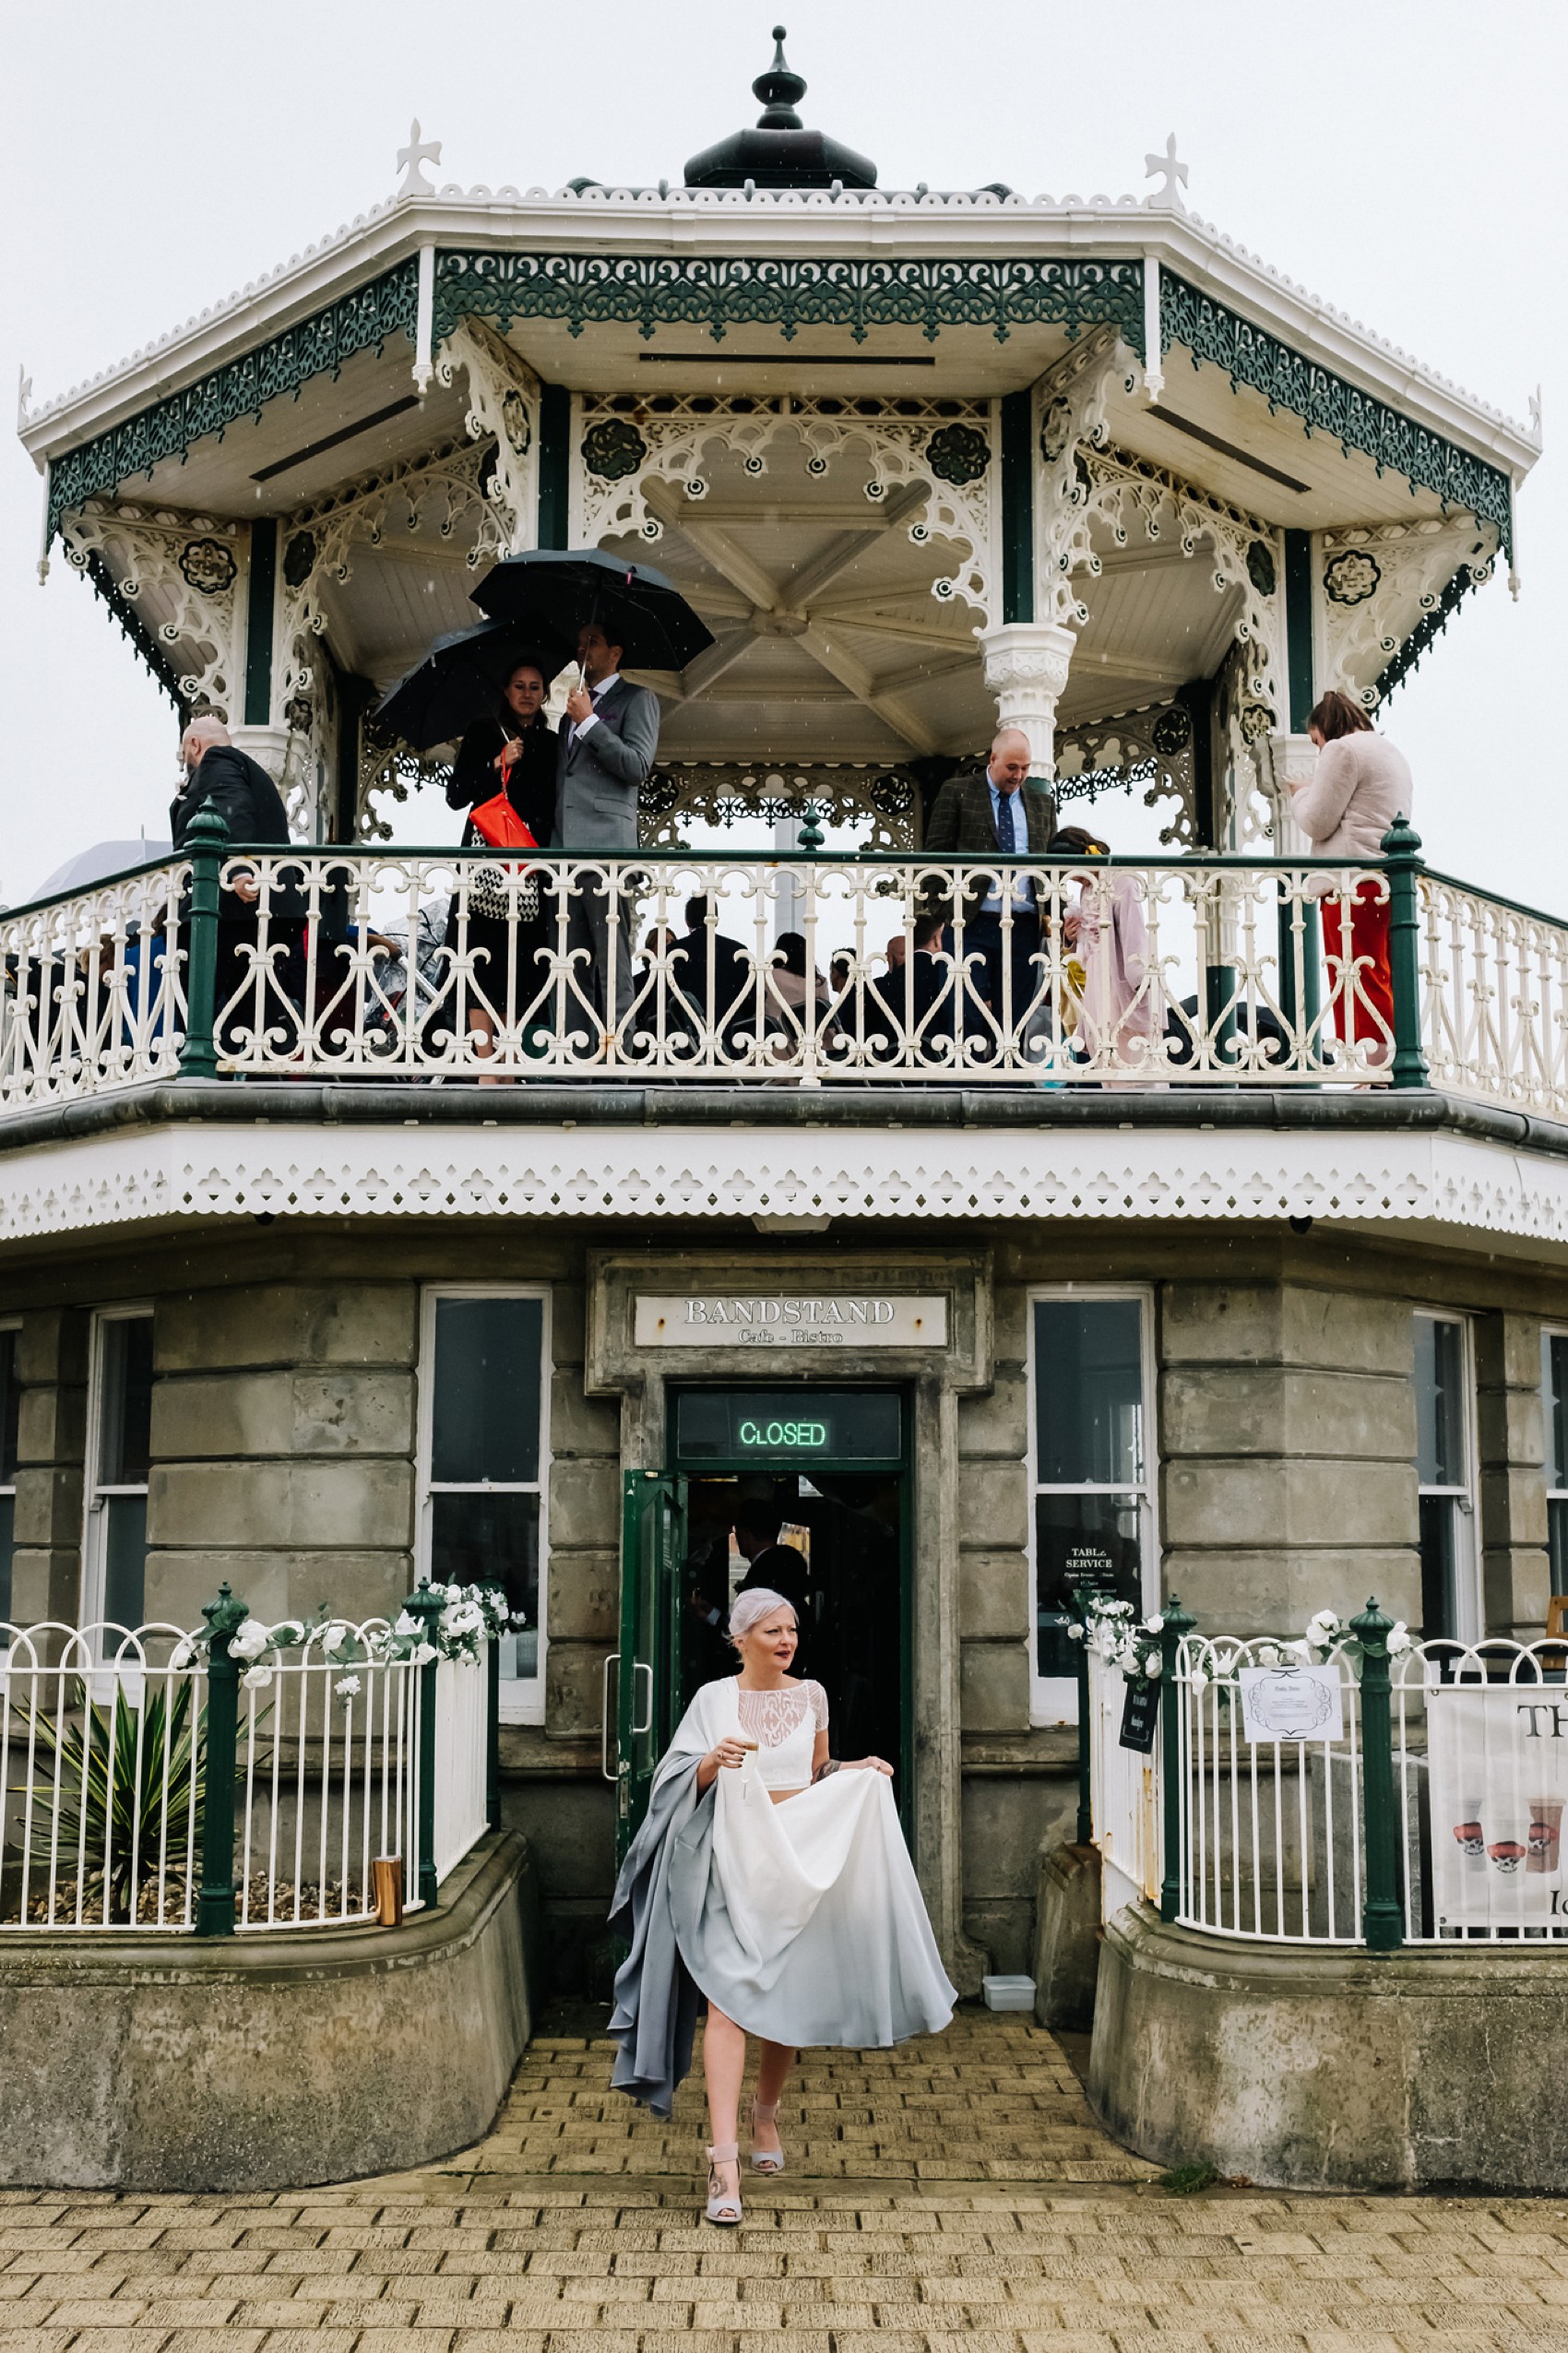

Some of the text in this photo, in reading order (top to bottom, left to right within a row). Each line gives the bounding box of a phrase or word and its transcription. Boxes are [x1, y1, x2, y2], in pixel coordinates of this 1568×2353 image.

[684, 1301, 895, 1324] BANDSTAND
[739, 1329, 775, 1343] Cafe
[790, 1329, 843, 1343] Bistro
[740, 1421, 826, 1445] CLOSED
[1065, 1559, 1112, 1568] SERVICE
